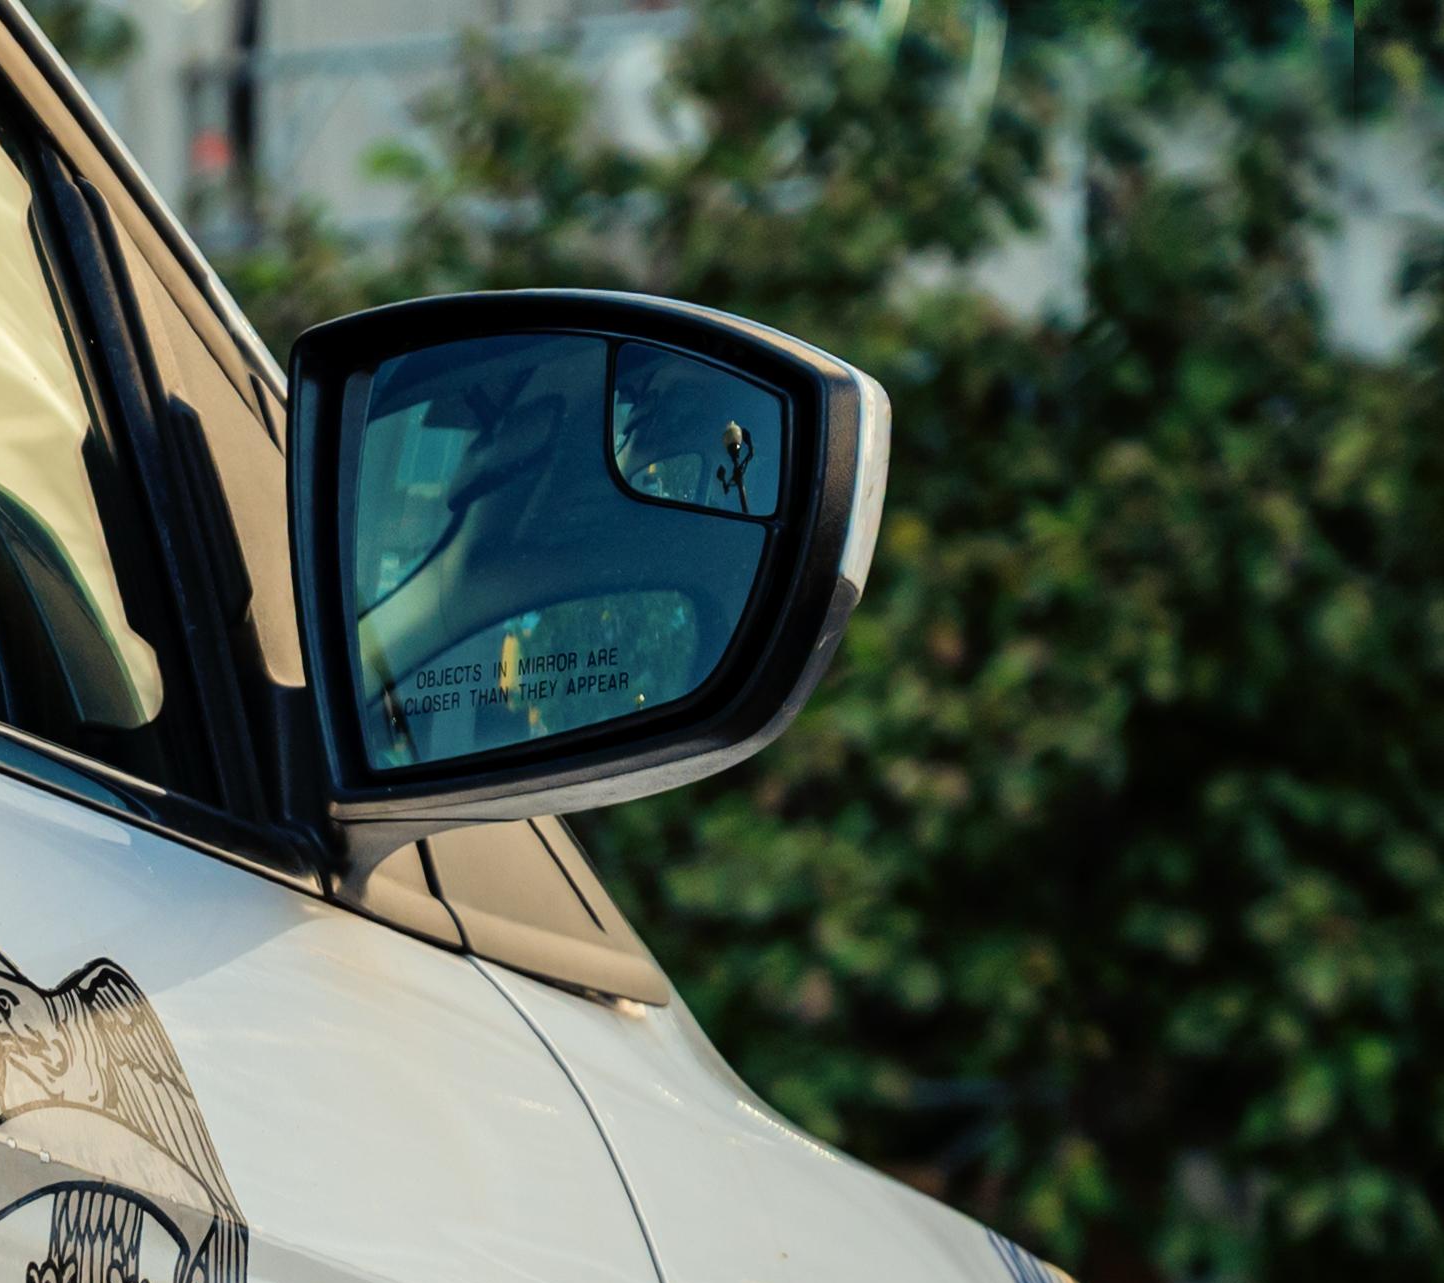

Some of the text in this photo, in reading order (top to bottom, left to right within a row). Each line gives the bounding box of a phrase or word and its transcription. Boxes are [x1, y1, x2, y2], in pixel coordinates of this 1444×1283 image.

[416, 647, 618, 690] OBJECTS IN MIRROR ARE
[404, 671, 630, 717] CLOSER THAN THEY APPEAR
